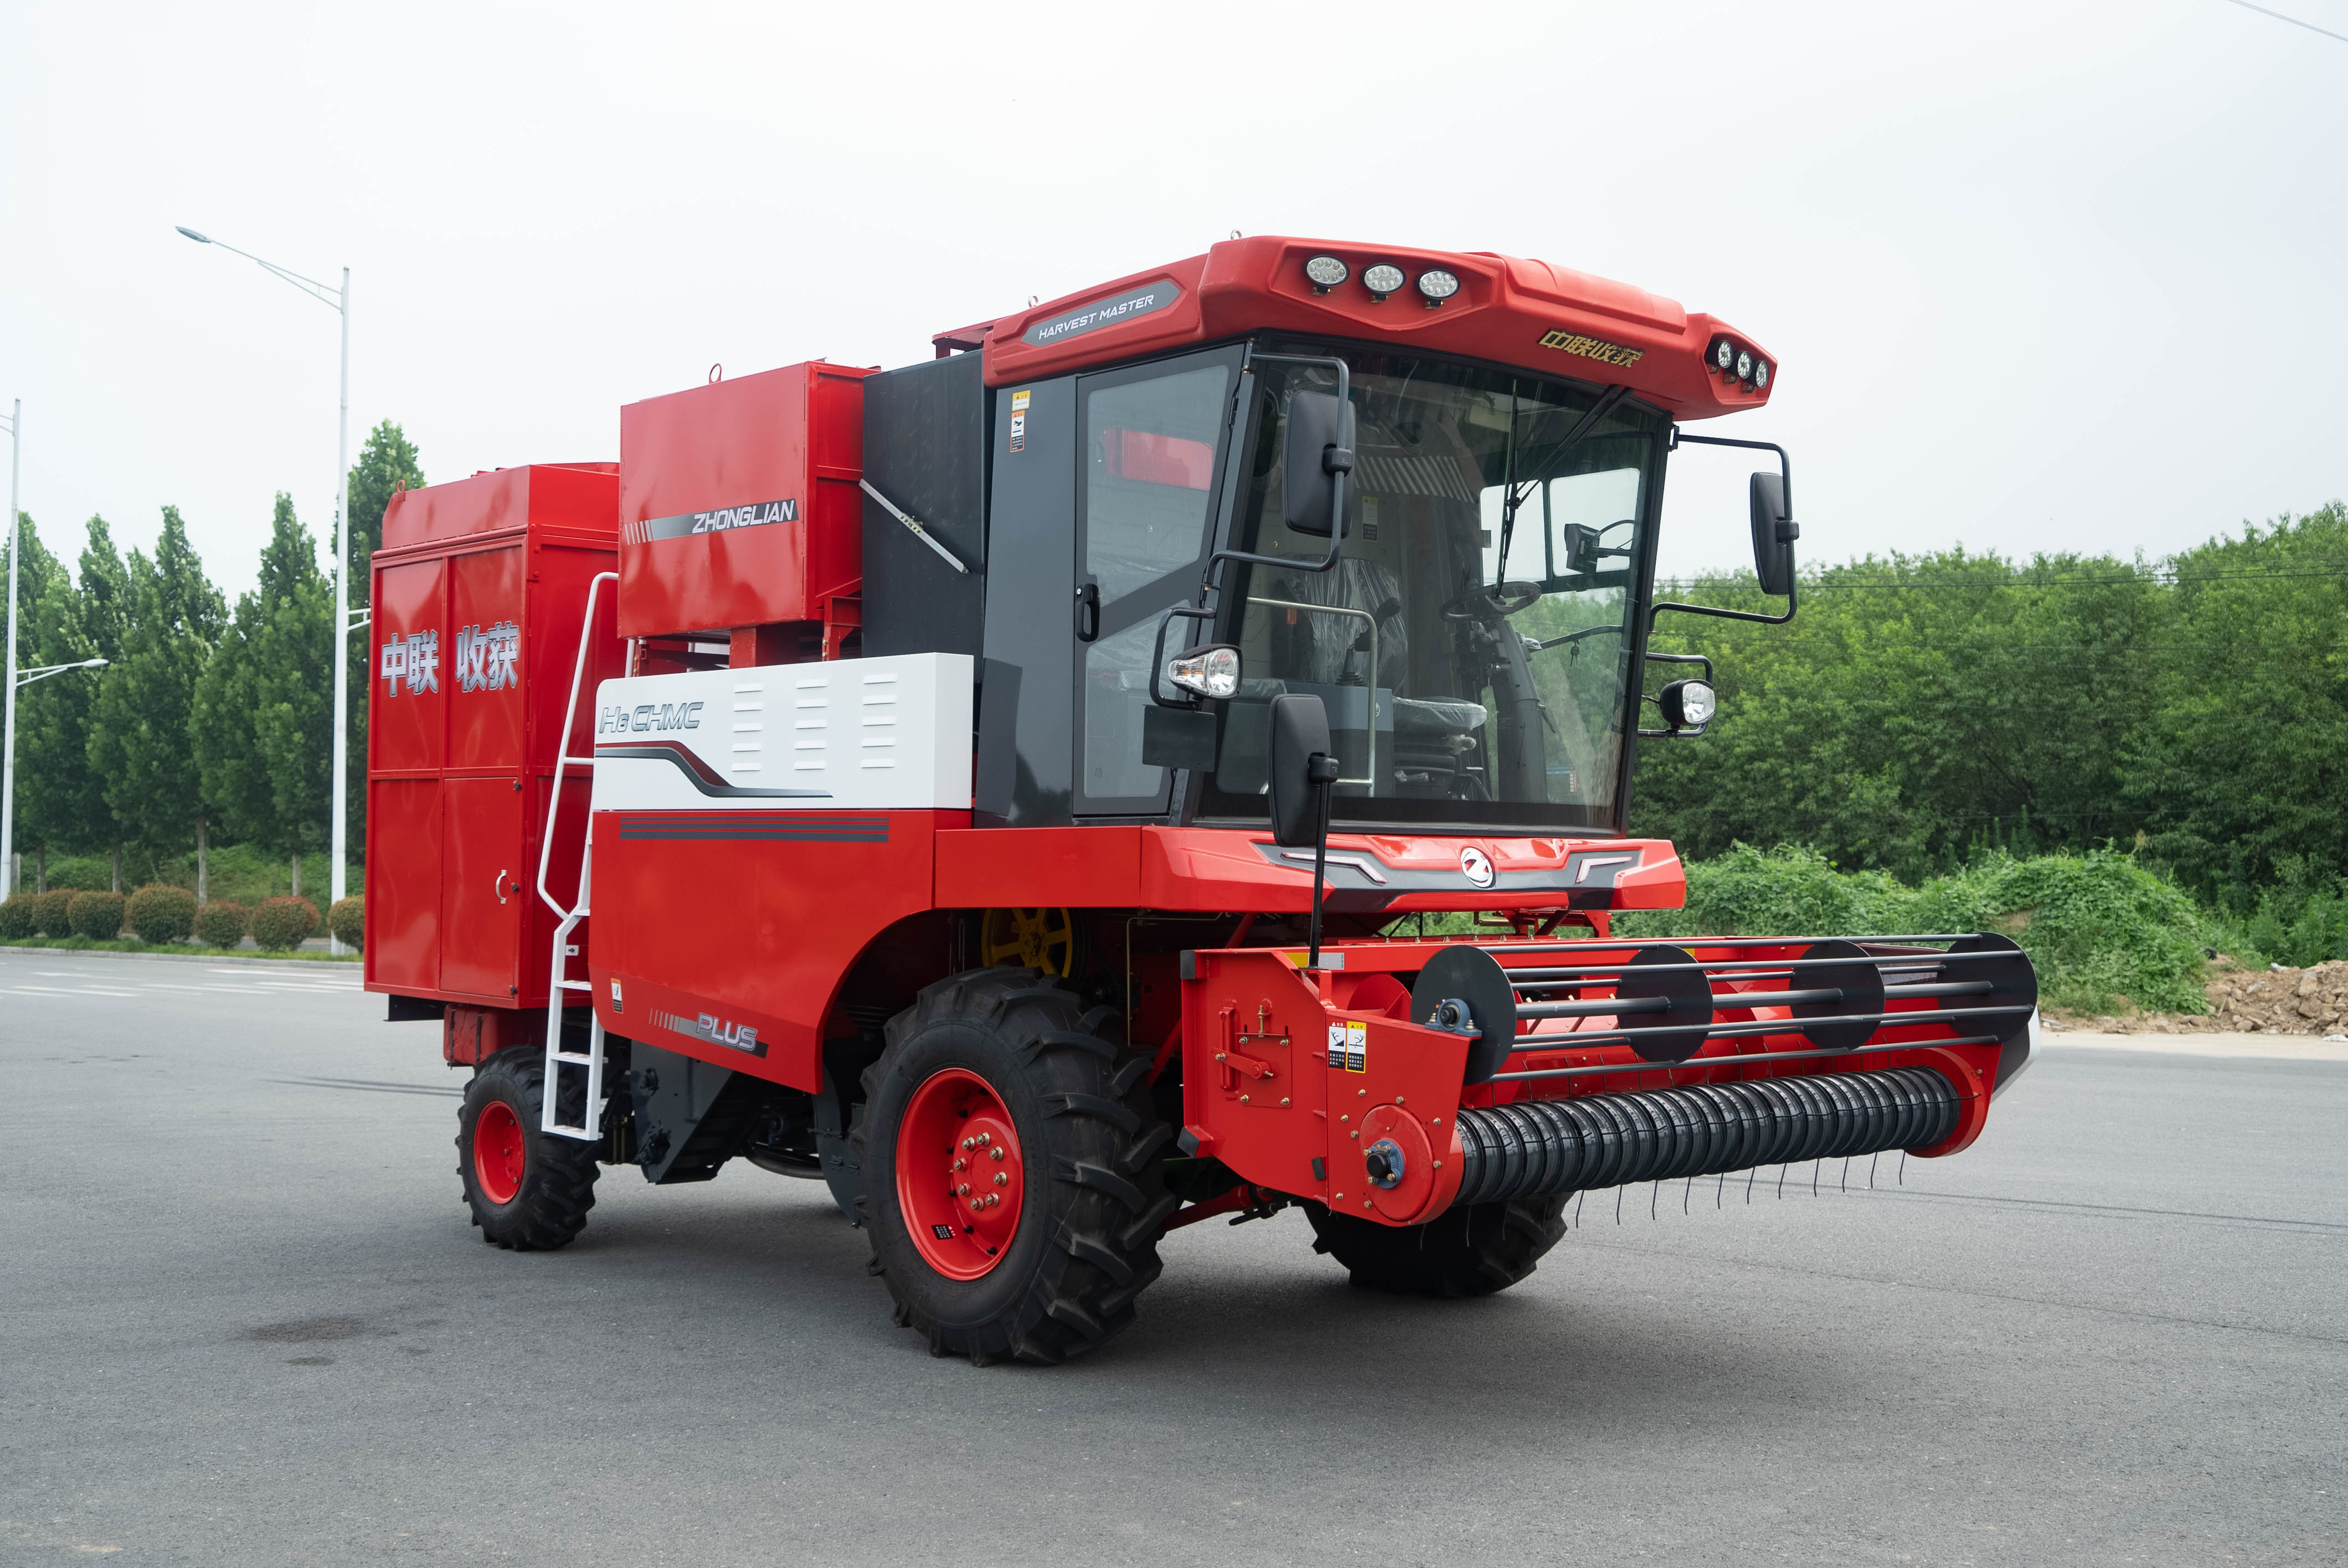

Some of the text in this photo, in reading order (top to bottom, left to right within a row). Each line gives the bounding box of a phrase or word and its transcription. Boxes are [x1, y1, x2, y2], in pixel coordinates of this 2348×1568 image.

[1038, 294, 1155, 340] HARVEST MASTER
[692, 499, 795, 534] ZHONGLIAN
[631, 702, 704, 732] CHMC
[695, 1012, 758, 1051] PLUS
